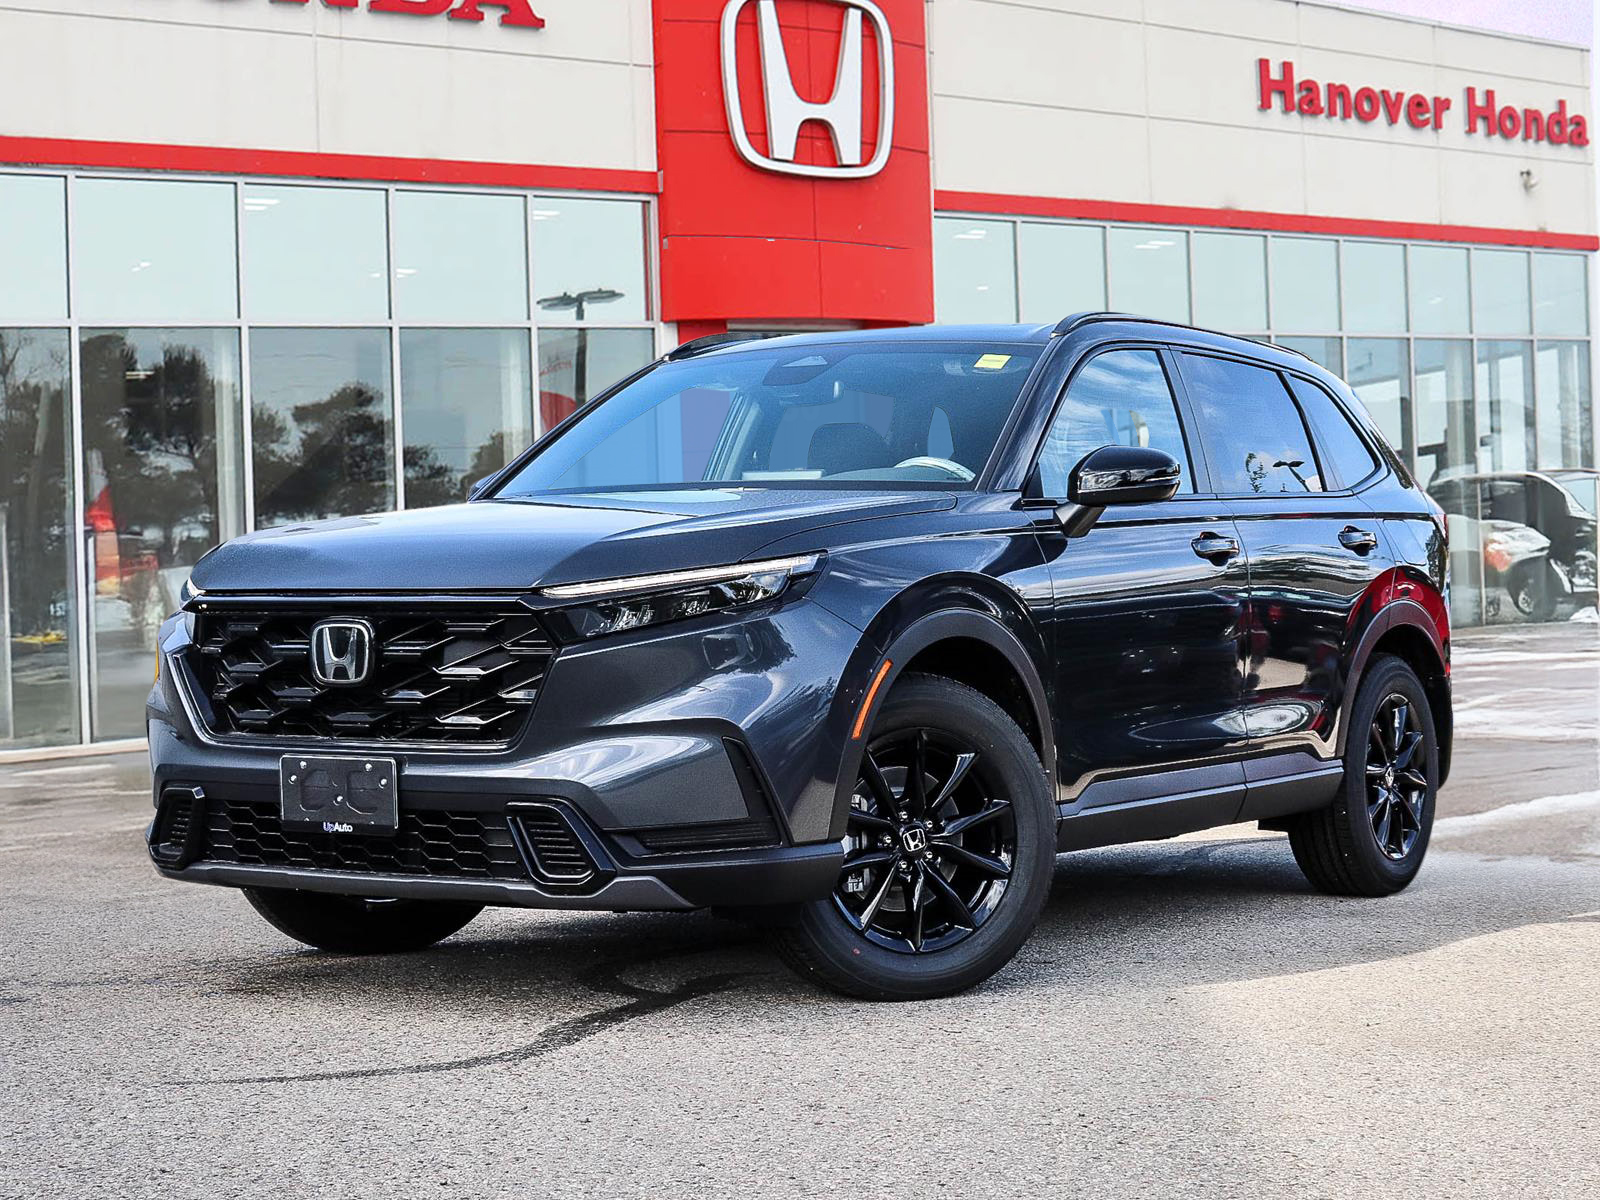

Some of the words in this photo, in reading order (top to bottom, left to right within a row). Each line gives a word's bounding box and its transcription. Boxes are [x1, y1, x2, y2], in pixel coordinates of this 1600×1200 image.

[1257, 57, 1451, 130] Hanover
[1465, 86, 1590, 147] Honda
[323, 821, 353, 833] UpAuto
